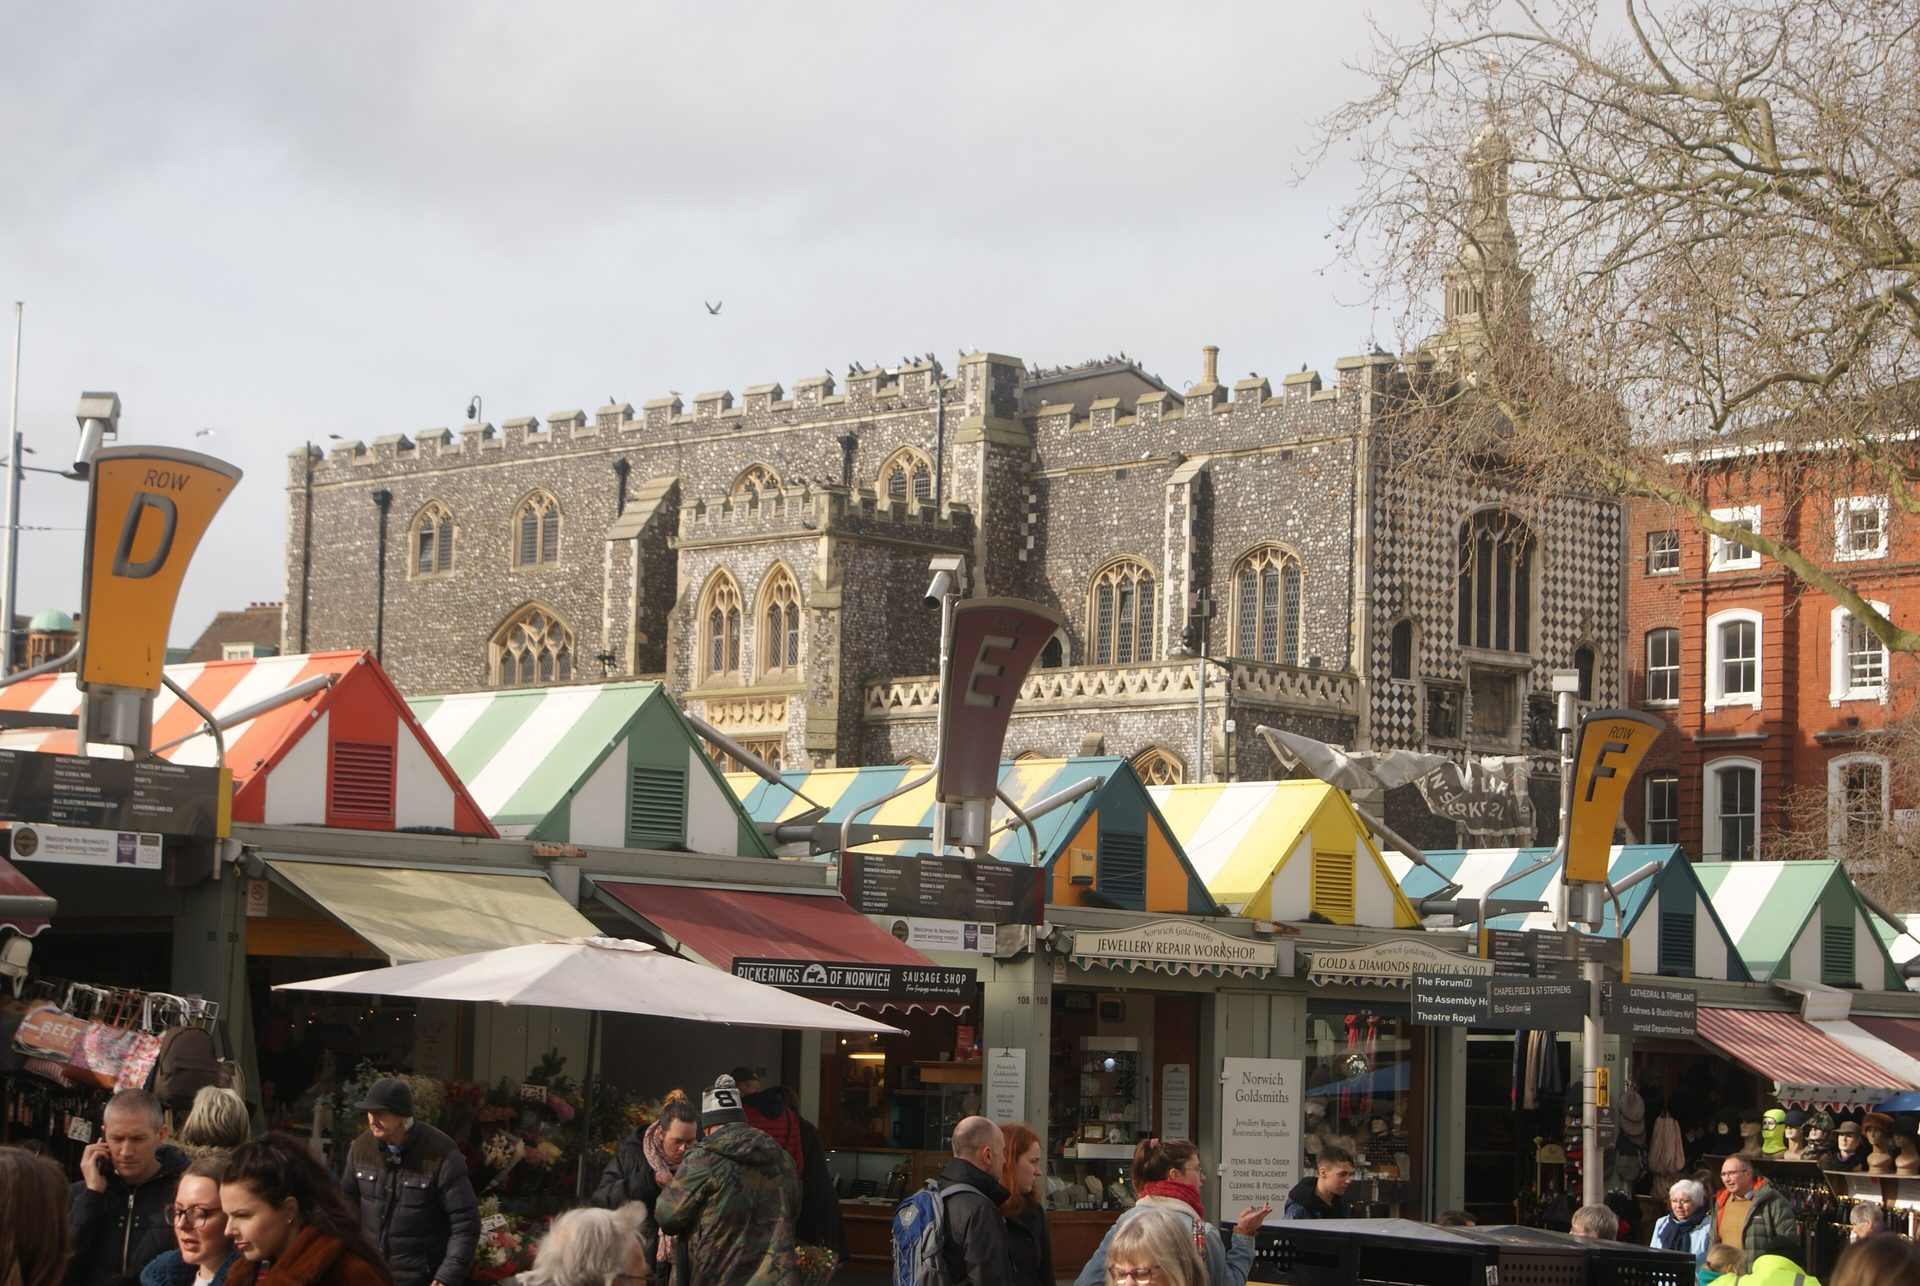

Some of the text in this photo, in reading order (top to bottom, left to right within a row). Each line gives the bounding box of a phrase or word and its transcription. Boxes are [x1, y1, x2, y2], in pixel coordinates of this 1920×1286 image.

[144, 469, 190, 492] ROW
[112, 492, 178, 579] D
[964, 634, 1018, 708] E
[1608, 726, 1635, 740] ROW
[1585, 742, 1628, 802] F
[45, 834, 73, 842] Welcome
[1142, 926, 1214, 942] Norwich Goldsmiths
[1097, 938, 1154, 953] JEWELLERY
[1156, 942, 1191, 956] REPAIR
[1374, 945, 1438, 960] Norwich Goldsmiths
[1318, 956, 1486, 975] GOLD & DIAMONDS BOUGHT & SOLD
[737, 966, 890, 987] PICKERINGS OF NORWICH
[902, 971, 967, 985] SAUSAGE SHOP
[1417, 977, 1463, 987] The Forum
[1494, 986, 1530, 996] CHAPELFIELD
[1536, 987, 1544, 995] ST
[1545, 986, 1571, 994] STEPHENS
[1630, 988, 1660, 999] CATHEDRAL
[1666, 992, 1694, 1002] TOMBLAND
[1017, 996, 1030, 1005] 108
[1036, 996, 1048, 1005] 108
[1418, 994, 1433, 1003] The
[1435, 995, 1476, 1006] Assembly
[1505, 1005, 1523, 1013] Station
[1622, 1005, 1628, 1014] St
[1629, 1006, 1650, 1015] Andrews
[1651, 1008, 1655, 1016] &
[1657, 1008, 1683, 1018] Blackfriars
[1418, 1012, 1476, 1024] Theatre Royal
[1633, 1024, 1694, 1035] Jarrold Department Store
[1603, 1053, 1616, 1061] 128
[1242, 1071, 1283, 1086] Norwich
[715, 1091, 737, 1107] 8
[1235, 1089, 1289, 1103] Goldsmiths
[1236, 1119, 1260, 1128] Jewellery
[1261, 1120, 1280, 1128] Repairs
[1232, 1128, 1290, 1138] Restoration Specialists
